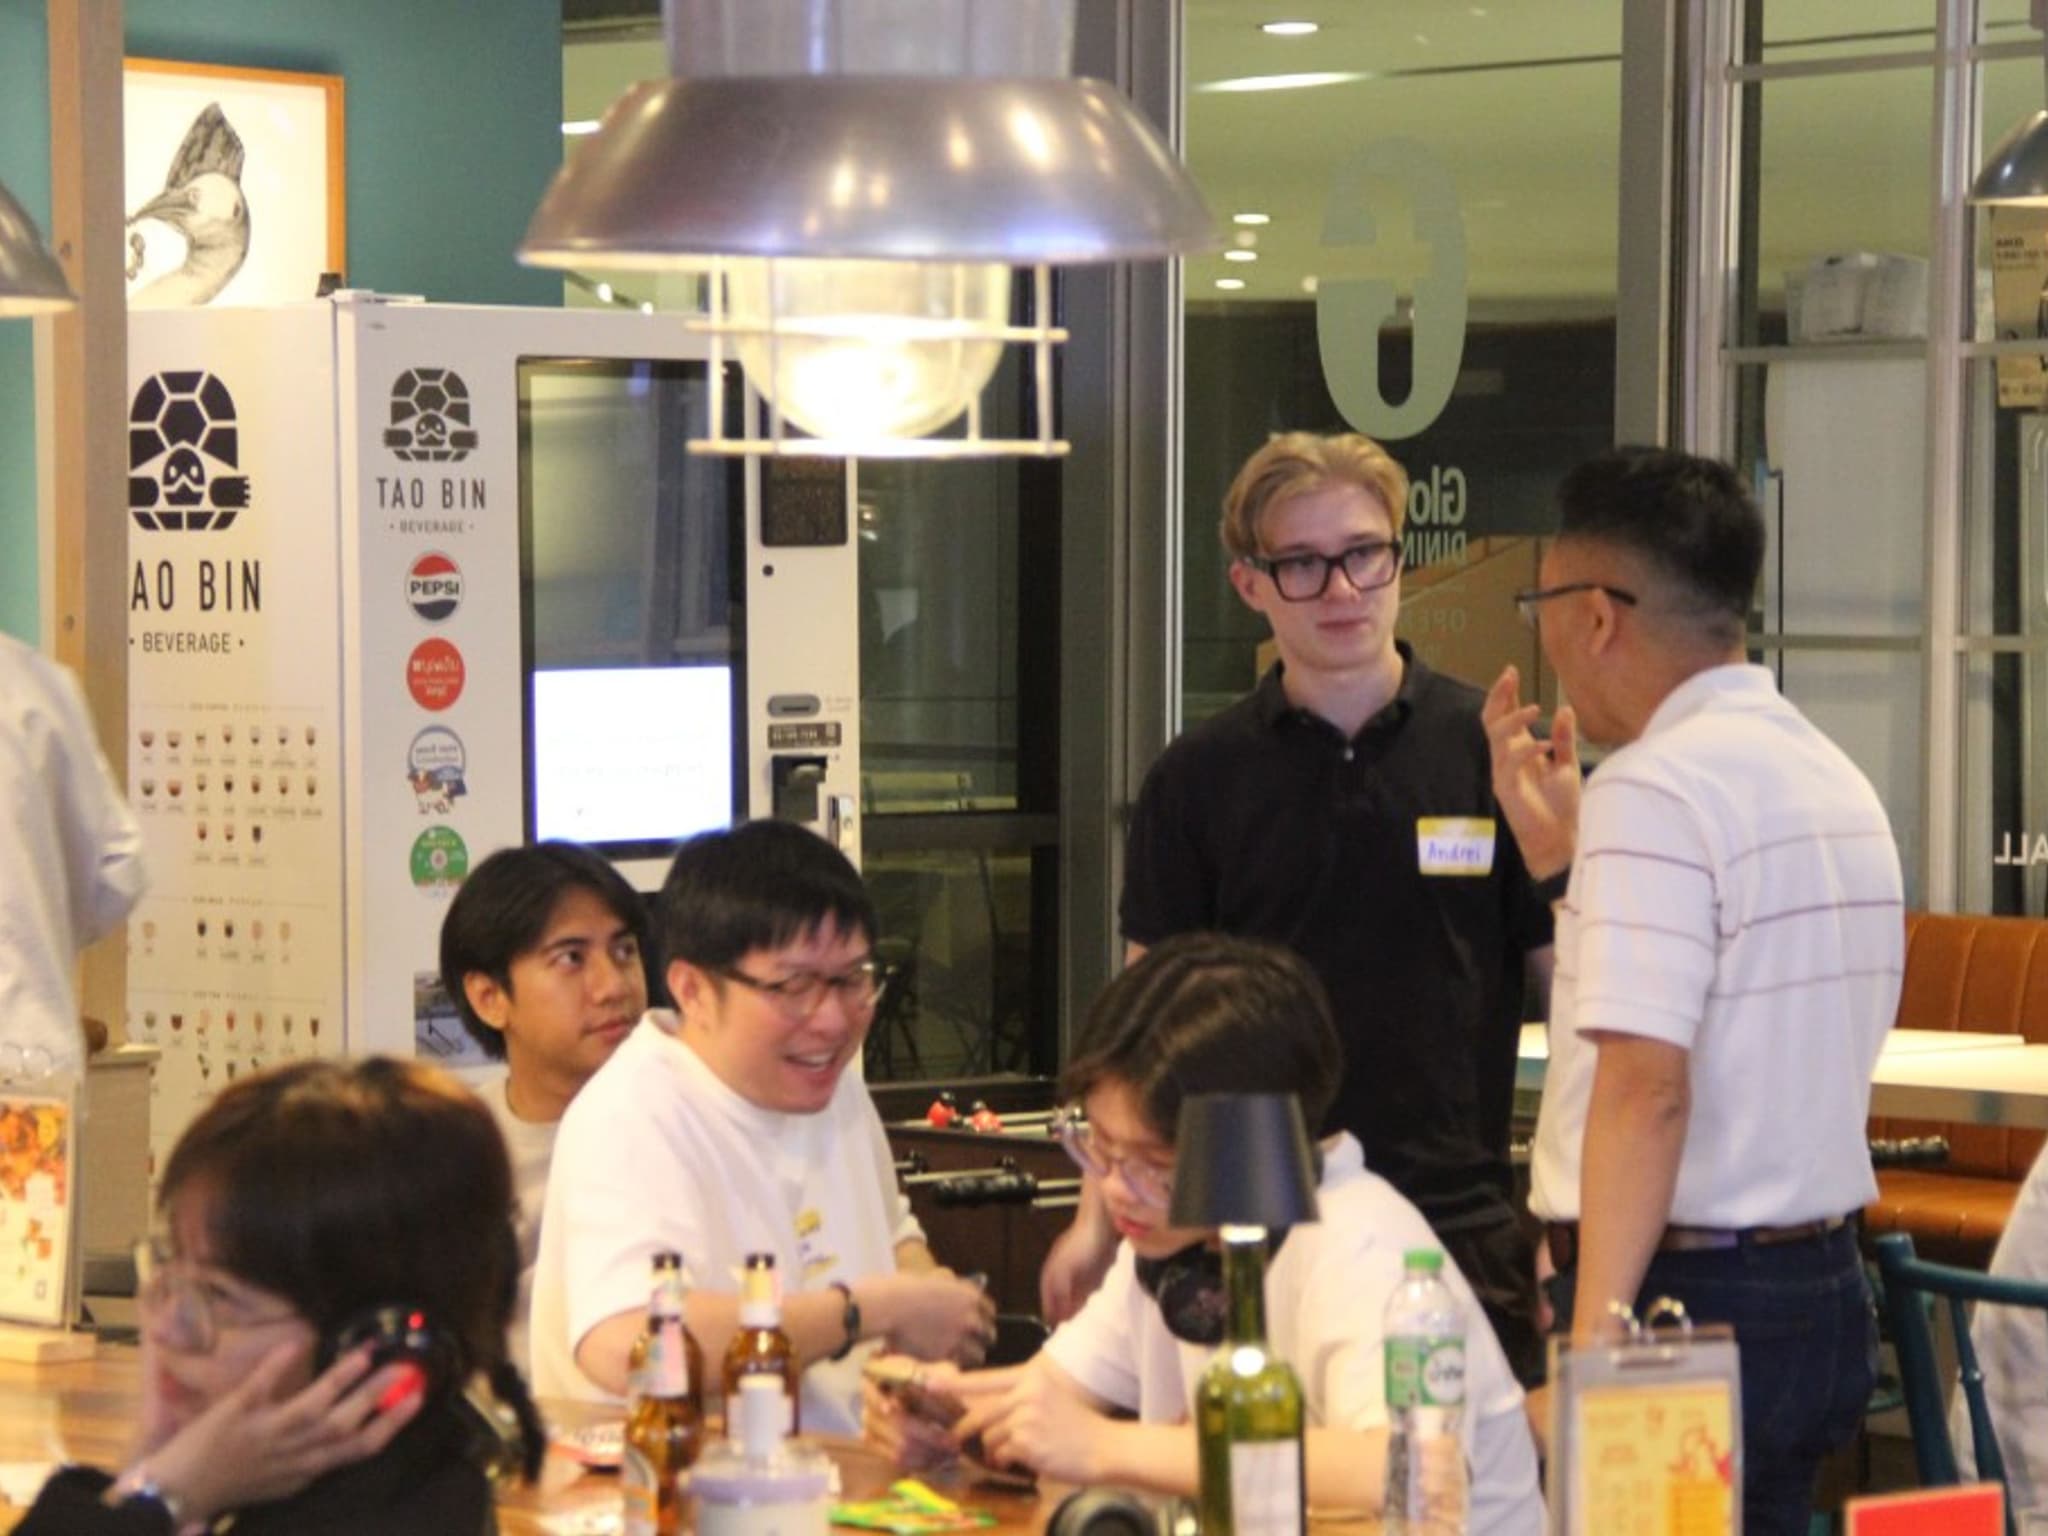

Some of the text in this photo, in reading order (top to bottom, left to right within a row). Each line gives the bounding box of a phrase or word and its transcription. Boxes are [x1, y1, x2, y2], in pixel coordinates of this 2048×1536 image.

[376, 477, 485, 510] TAO BIN
[400, 519, 464, 534] BEVERAGE
[131, 559, 261, 613] AO BIN
[410, 579, 460, 596] PEPSI
[142, 631, 232, 653] BEVERAGE
